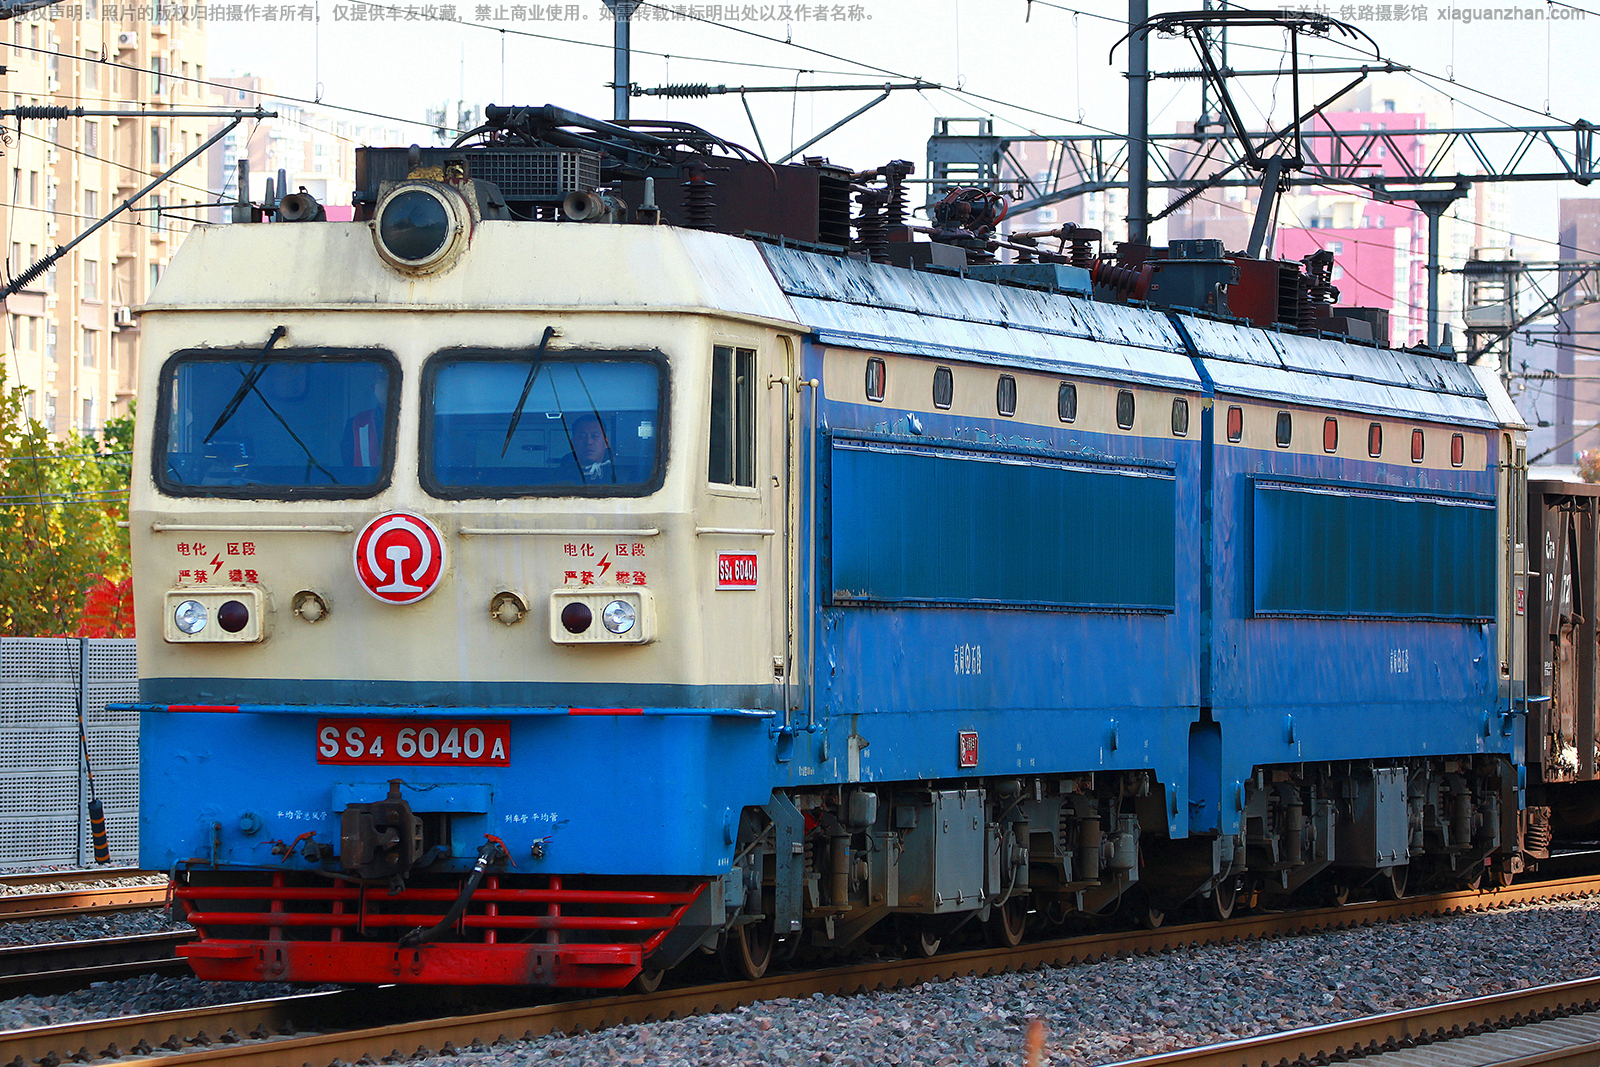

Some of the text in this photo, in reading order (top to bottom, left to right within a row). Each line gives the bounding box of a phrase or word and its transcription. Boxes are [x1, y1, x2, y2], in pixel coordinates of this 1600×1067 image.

[177, 542, 256, 556] 电化 区段
[564, 543, 646, 557] 电化 区段
[178, 568, 259, 584] 严禁 攀登
[564, 571, 647, 585] 严禁 攀登
[319, 726, 384, 758] SS4
